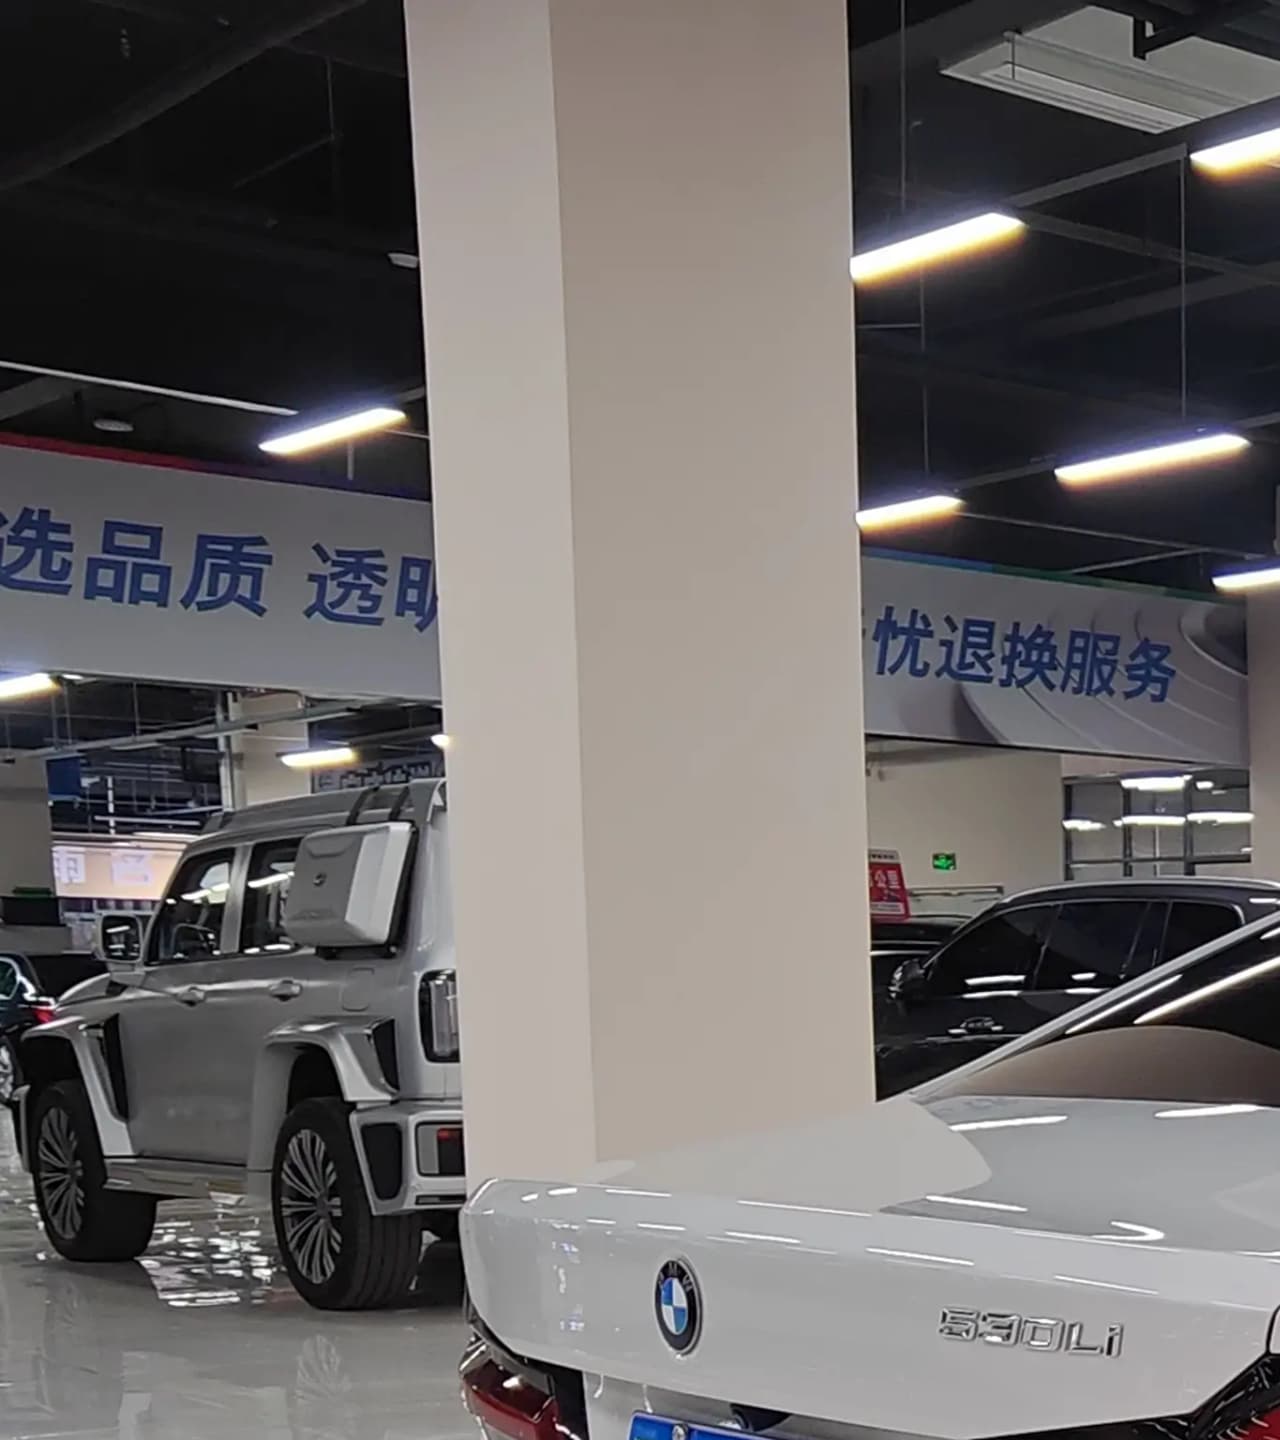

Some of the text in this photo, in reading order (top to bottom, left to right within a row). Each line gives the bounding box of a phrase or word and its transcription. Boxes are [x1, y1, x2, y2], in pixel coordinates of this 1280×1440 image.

[0, 506, 273, 617] 选品质
[862, 604, 1176, 702] 忧退换服务
[938, 1307, 1124, 1358] 530Li
